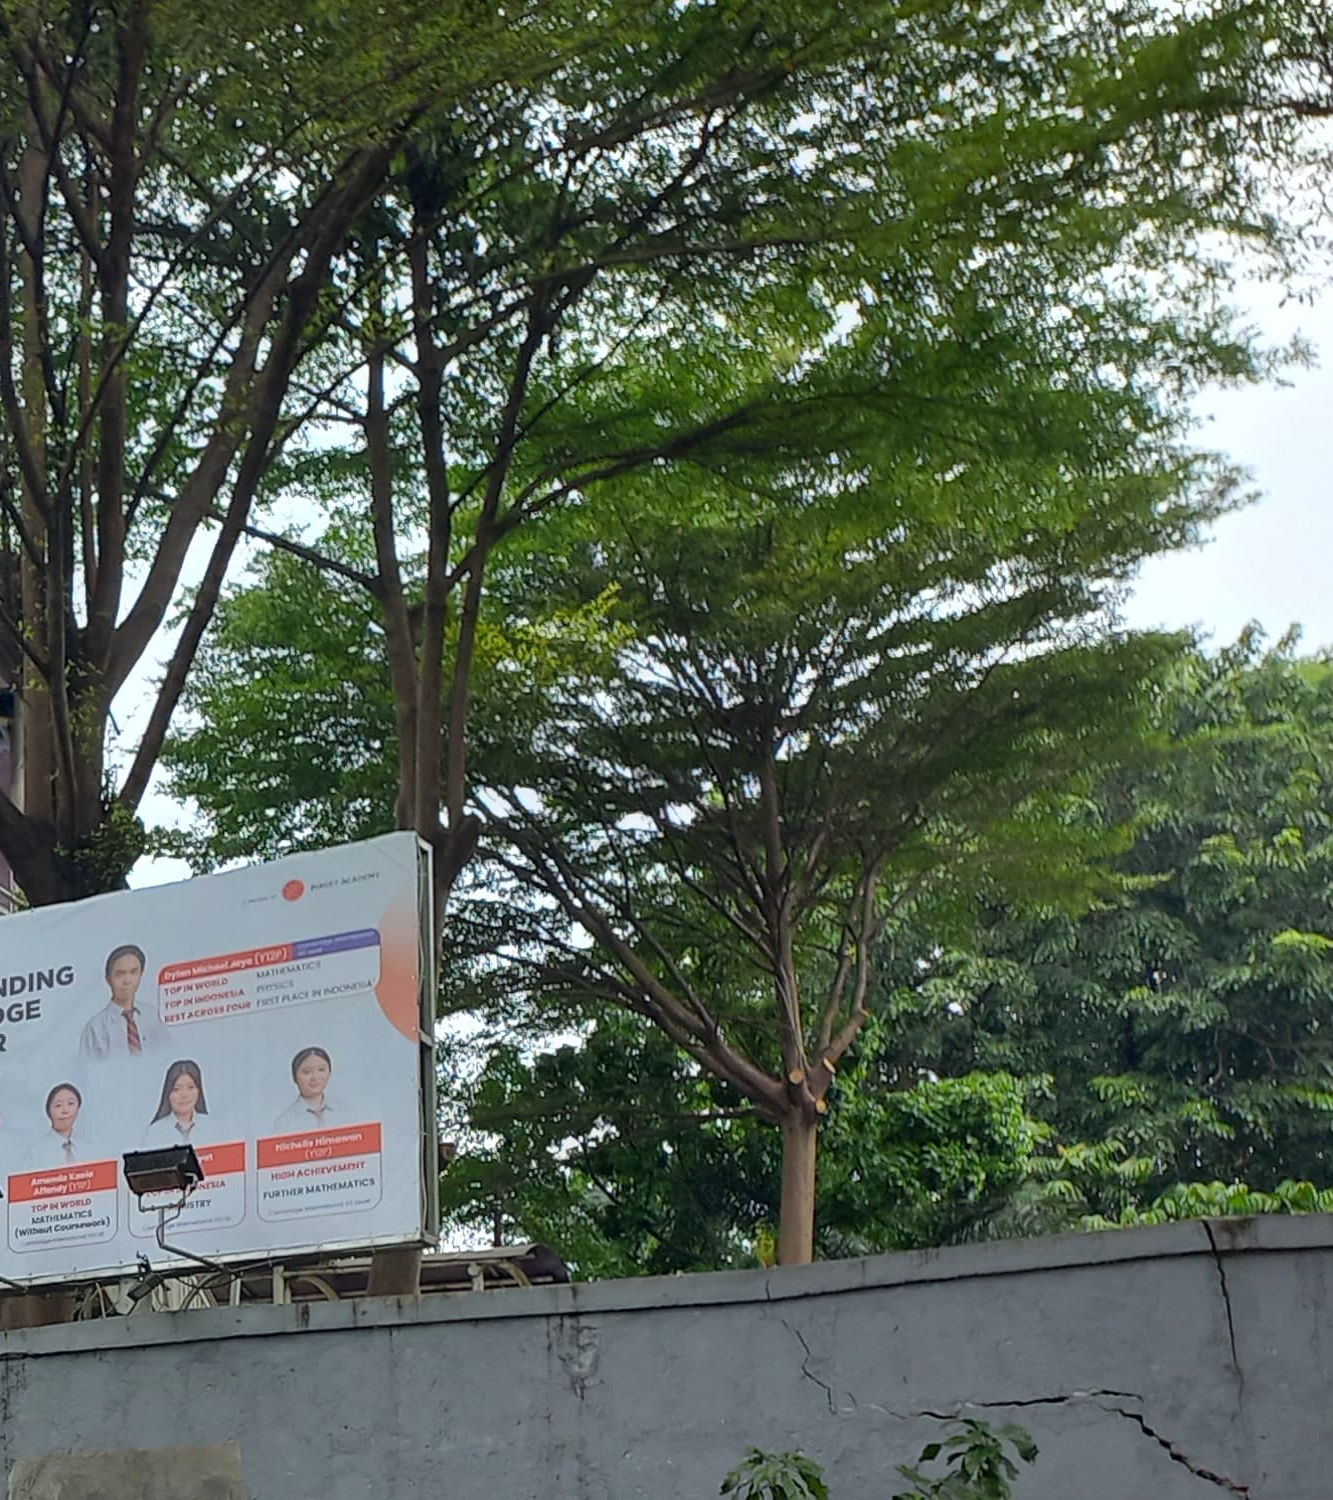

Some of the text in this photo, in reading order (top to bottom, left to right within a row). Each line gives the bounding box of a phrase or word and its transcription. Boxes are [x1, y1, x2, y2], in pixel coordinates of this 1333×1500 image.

[256, 960, 321, 978] MATHEMATICS
[164, 978, 228, 996] TOP IN WORLD
[281, 991, 309, 1003] PLACE
[312, 989, 322, 997] IN
[324, 979, 373, 995] INDONESIA
[164, 988, 245, 1009] TOP IN INDONESIA
[164, 1001, 252, 1023] BEST ACROSS FOUR
[271, 1161, 365, 1181] HIGH ACHIEVEMENT
[263, 1177, 376, 1200] FURTHER MATHEMATICS
[32, 1204, 49, 1213] TOP
[61, 1198, 92, 1209] WORLD
[31, 1209, 93, 1225] MATHEMATICS
[15, 1225, 53, 1239] (Without
